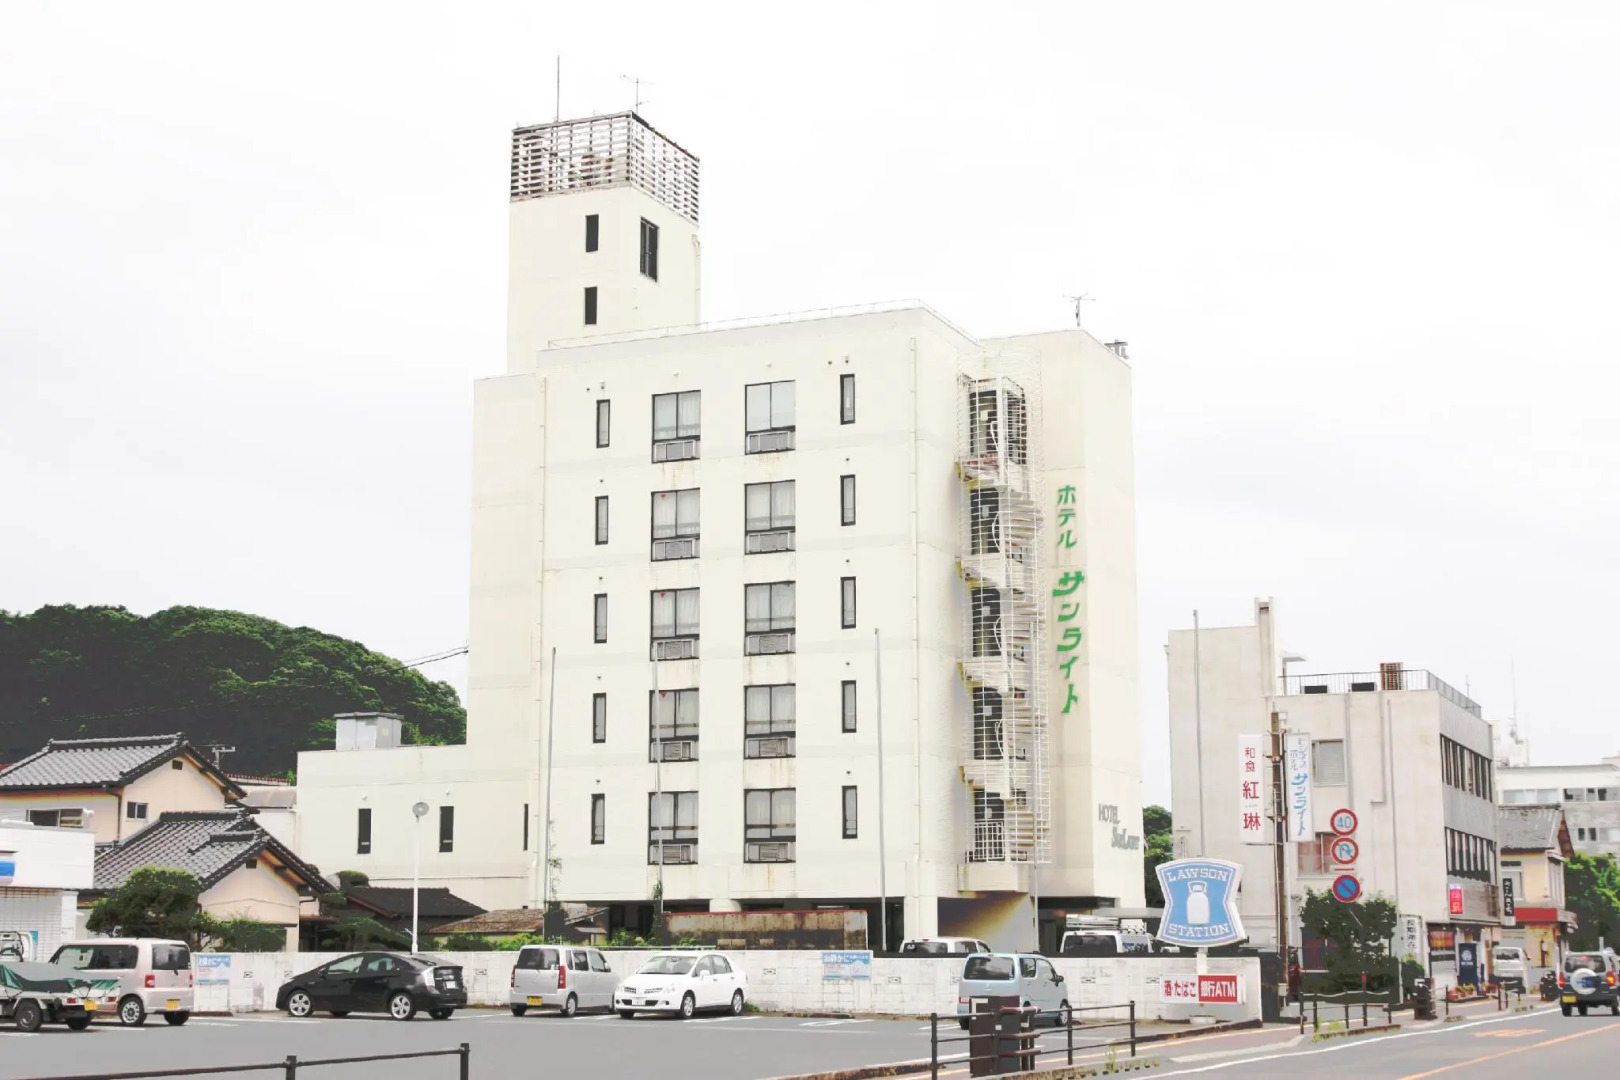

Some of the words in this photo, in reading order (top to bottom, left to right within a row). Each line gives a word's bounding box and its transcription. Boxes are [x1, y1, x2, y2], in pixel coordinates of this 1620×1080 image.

[1057, 485, 1077, 548] ホテル
[1052, 571, 1085, 714] サンライト
[1245, 747, 1255, 772] 和食
[1098, 803, 1120, 824] HOTEL
[1243, 781, 1261, 831] 紅琳
[1291, 773, 1308, 836] サンライト
[1337, 816, 1351, 829] 40
[1167, 868, 1228, 882] LAWSON
[1168, 923, 1229, 937] STATION
[1201, 980, 1236, 997] 銀行ATM
